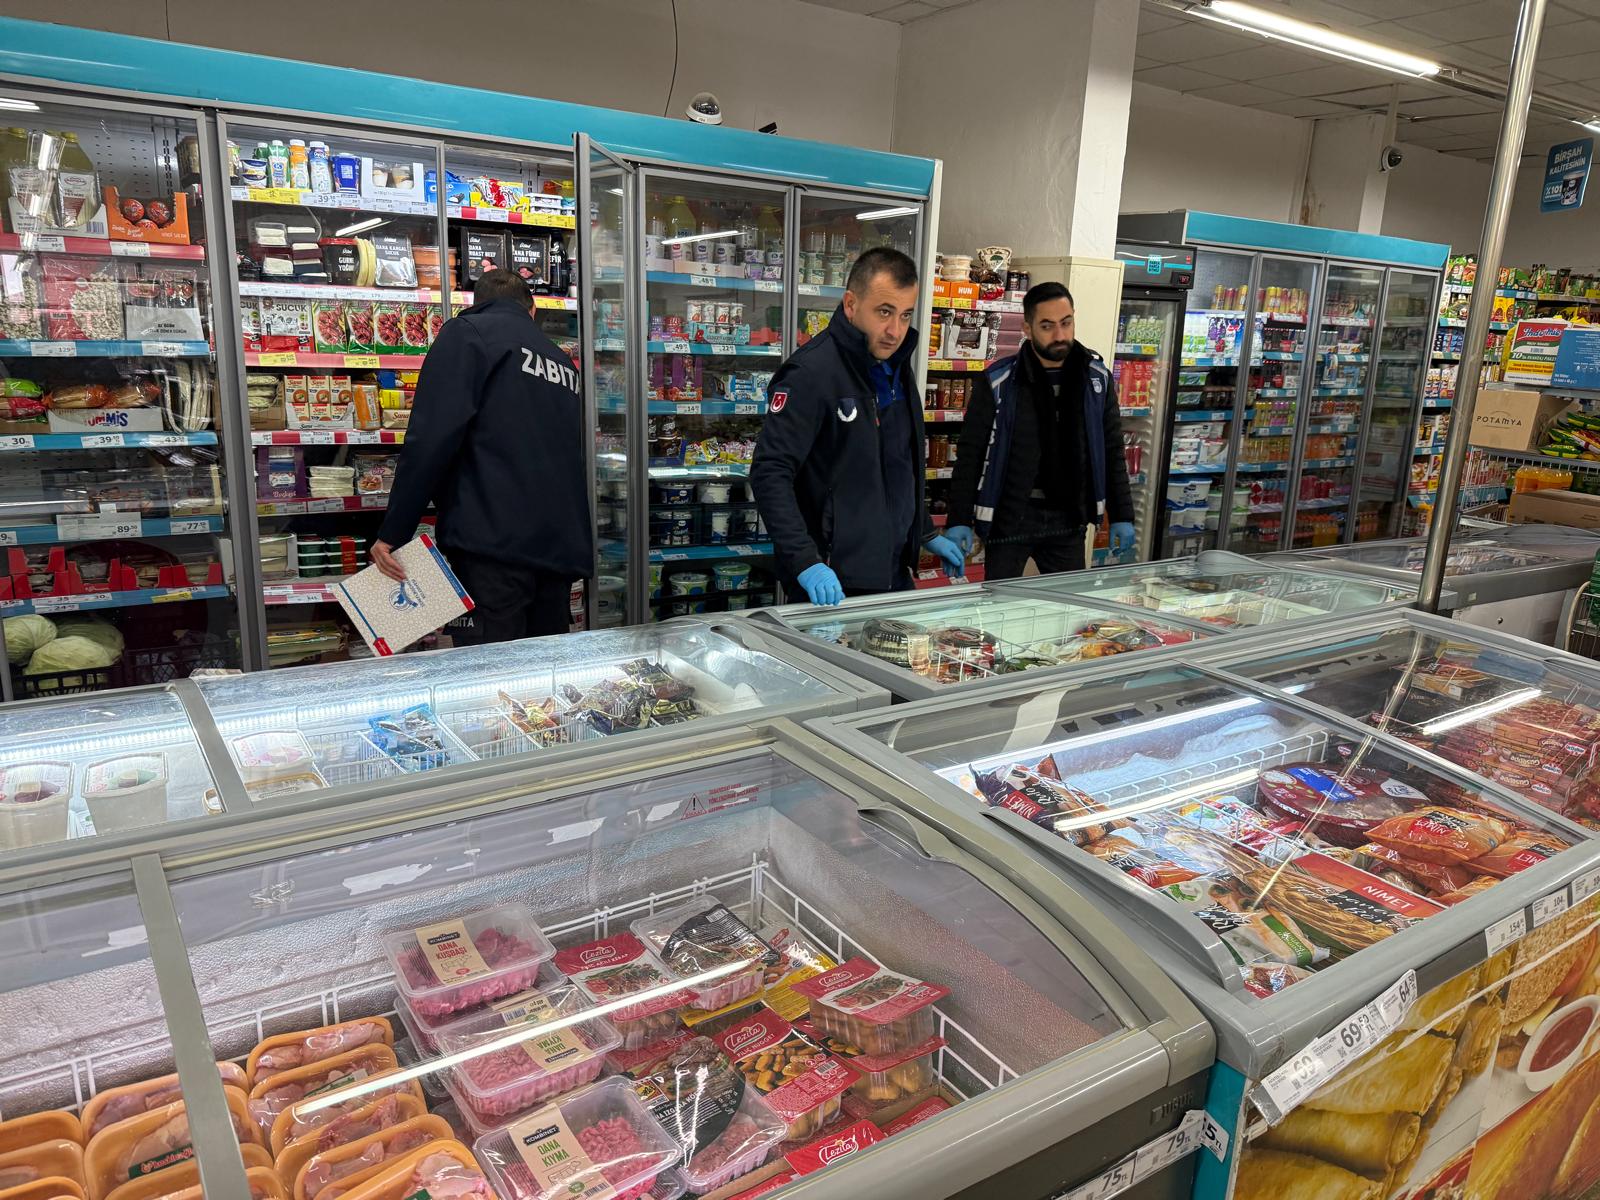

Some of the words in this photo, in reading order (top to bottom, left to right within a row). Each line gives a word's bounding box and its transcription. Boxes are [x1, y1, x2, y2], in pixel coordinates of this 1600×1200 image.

[240, 302, 258, 310] CUK
[276, 303, 306, 312] SUCUK
[730, 1025, 761, 1047] Lezita
[664, 1100, 688, 1117] IZGRA
[537, 1140, 561, 1155] DANA
[823, 1136, 857, 1160] Lezita
[1167, 1131, 1185, 1153] 79
[542, 1150, 570, 1168] KIYMA
[1102, 1167, 1123, 1191] 75
